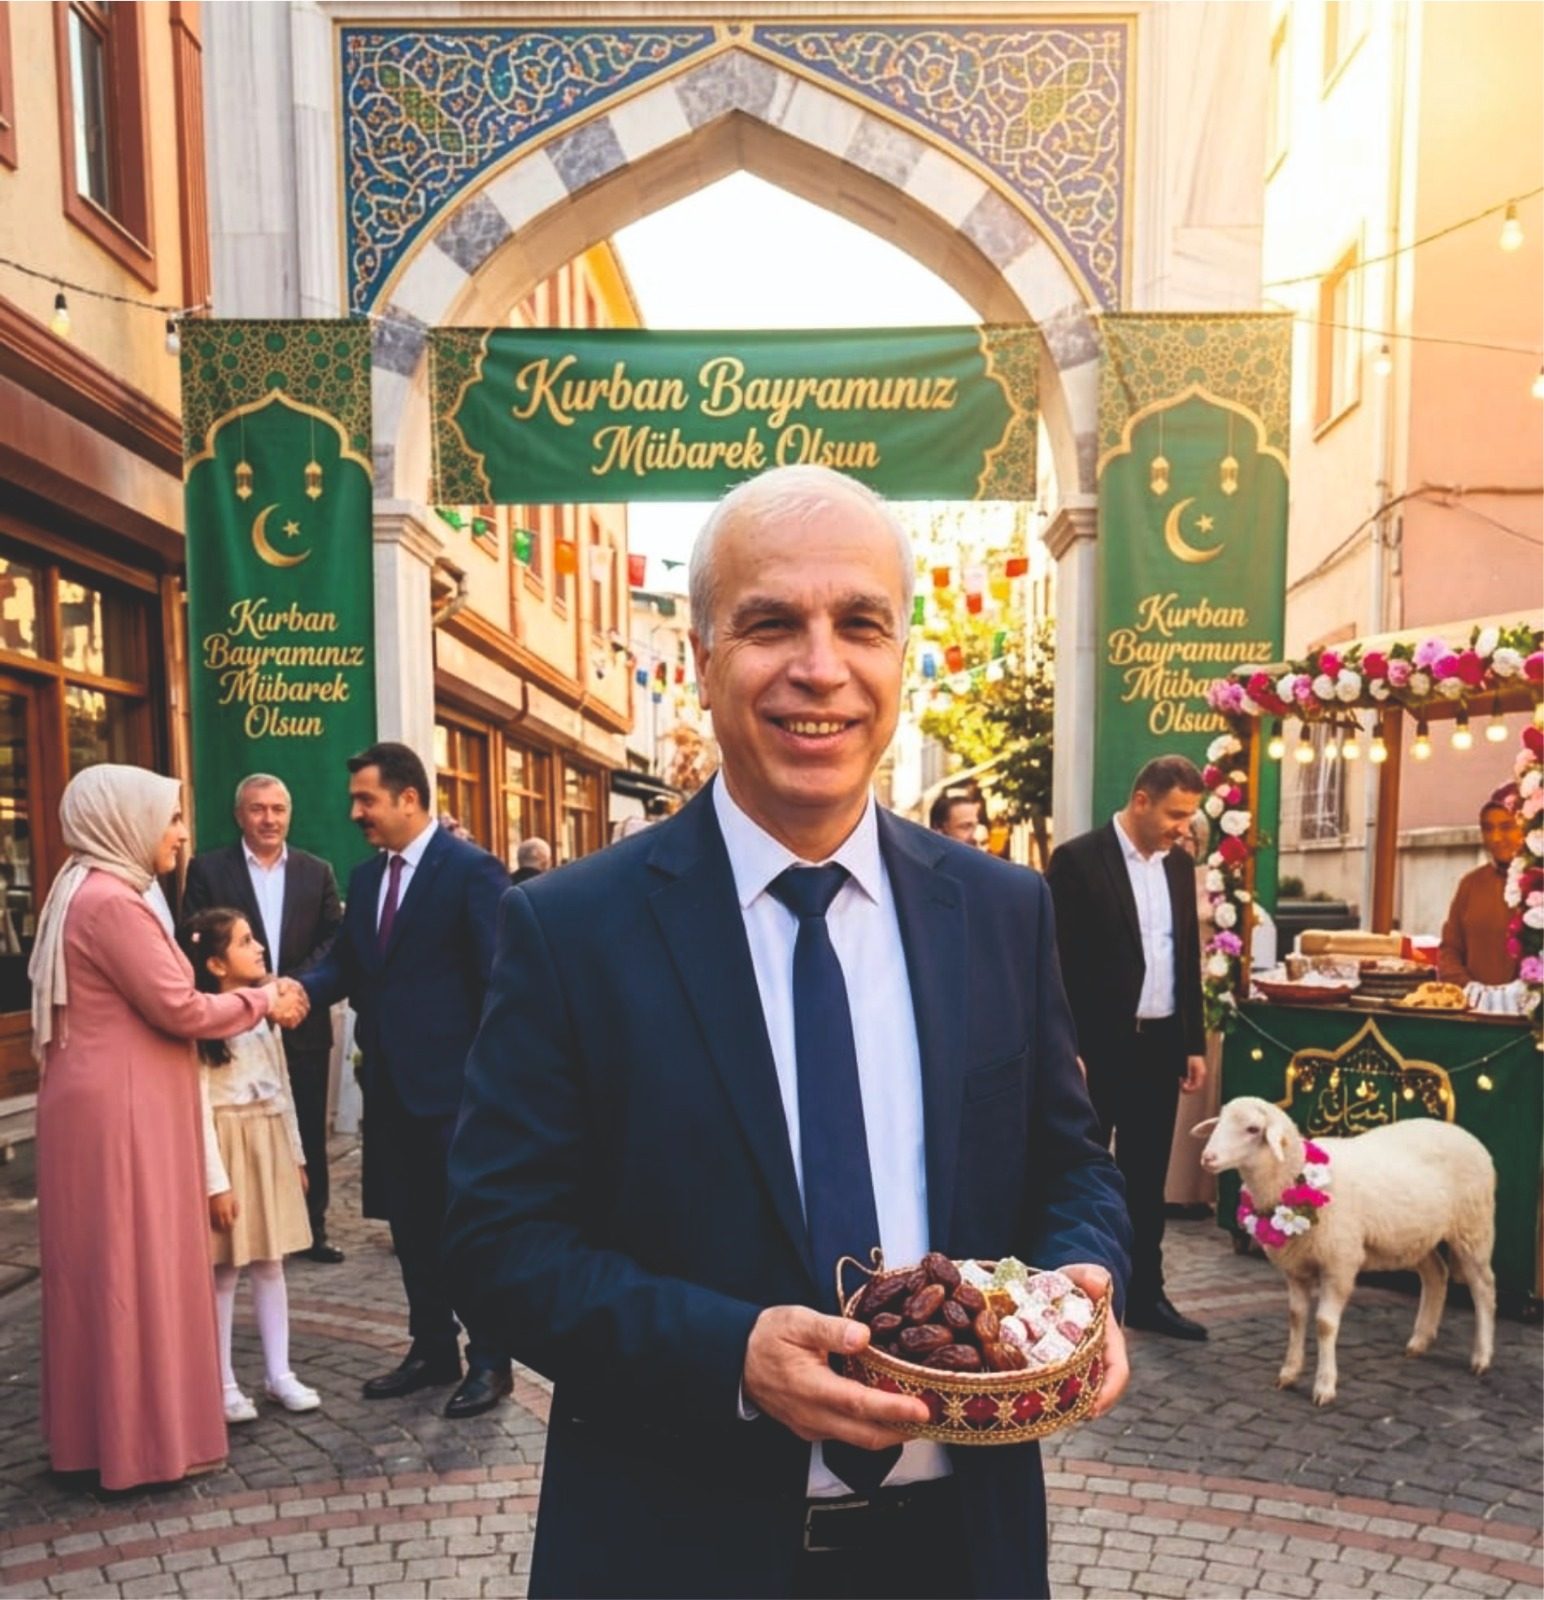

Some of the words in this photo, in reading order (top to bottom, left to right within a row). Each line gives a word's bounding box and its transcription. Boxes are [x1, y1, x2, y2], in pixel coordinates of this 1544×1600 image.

[512, 354, 688, 426] Kurban
[698, 356, 957, 429] Bayramınız
[591, 425, 767, 476] Mübarek
[775, 424, 880, 470] Olsun
[227, 597, 339, 640] Kurban
[1136, 592, 1249, 637] Kurban
[203, 632, 365, 677] Bayramınız
[218, 669, 350, 706] Mübarek
[1121, 666, 1209, 703] Müba
[244, 703, 325, 739] Olsun
[1149, 700, 1228, 735] Olsun
